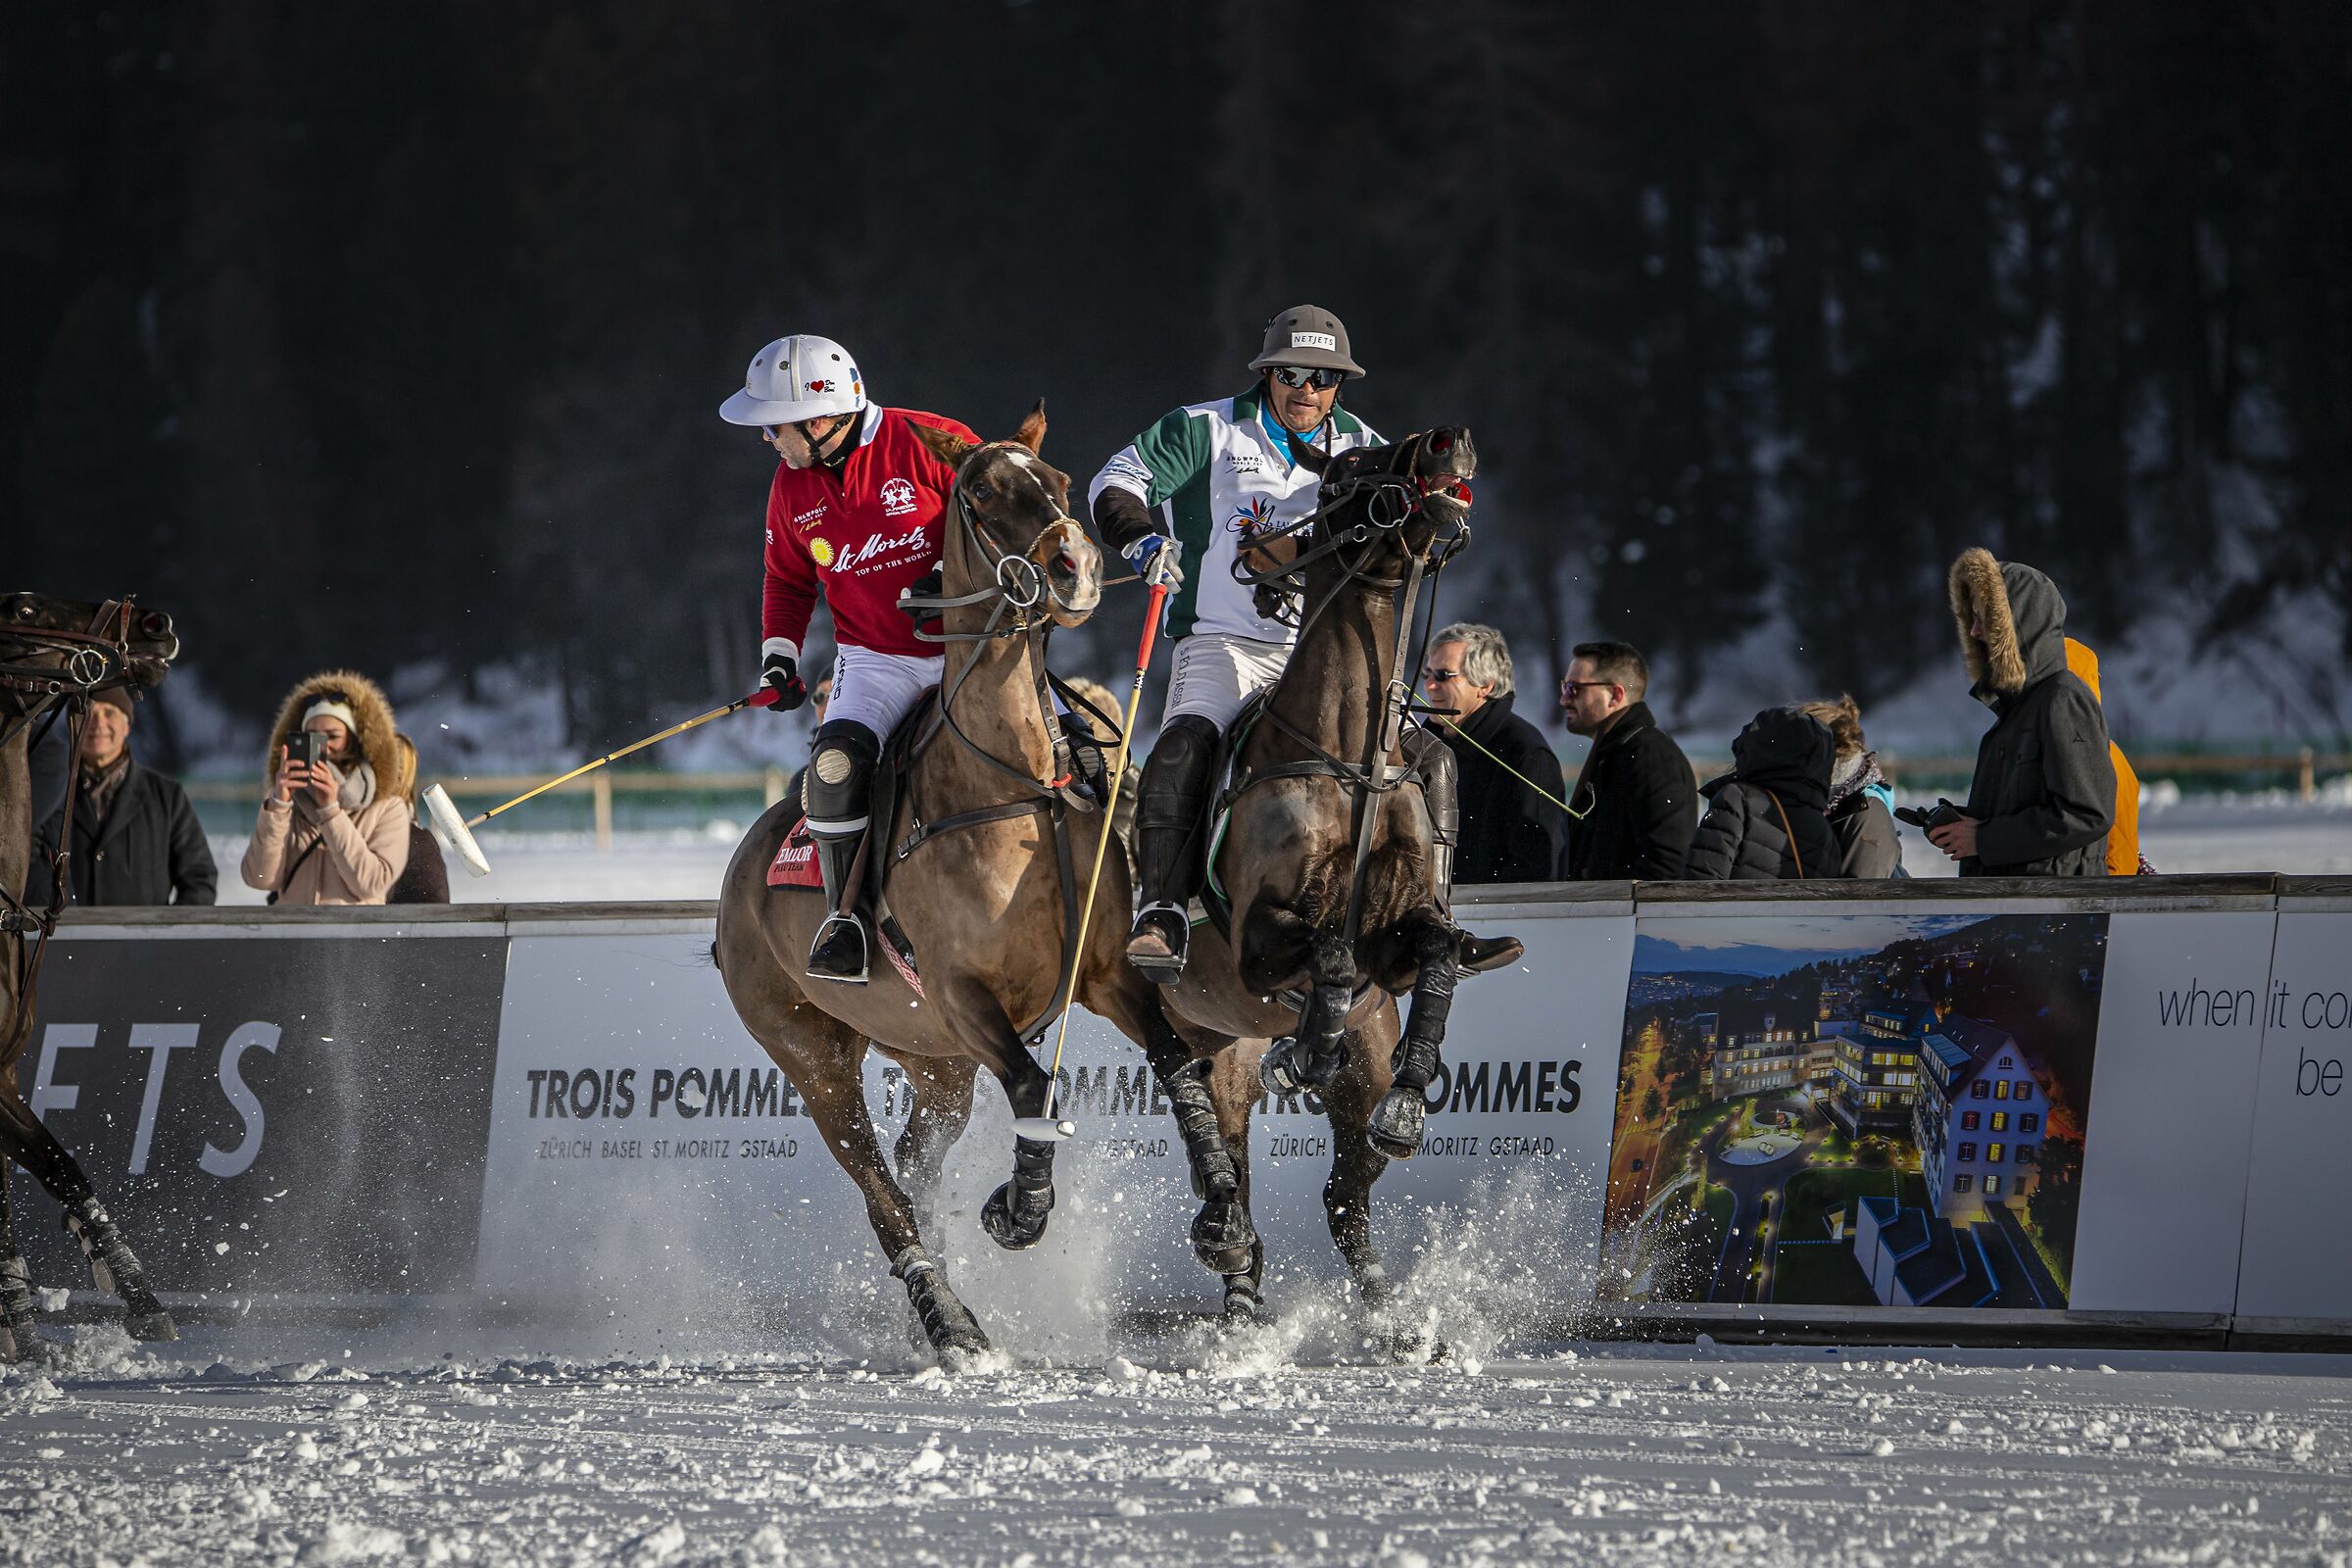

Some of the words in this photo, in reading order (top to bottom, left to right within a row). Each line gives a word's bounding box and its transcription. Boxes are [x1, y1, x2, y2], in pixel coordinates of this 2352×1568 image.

[1294, 335, 1334, 346] NETJETS
[852, 526, 925, 565] Moritz
[855, 567, 870, 577] TOP
[885, 560, 903, 568] THE
[904, 551, 932, 564] WORL
[2159, 977, 2255, 1026] when
[2270, 980, 2290, 1028] it
[2303, 992, 2352, 1029] co
[1424, 1059, 1583, 1114] OMMES
[2296, 1046, 2343, 1097] be
[527, 1068, 637, 1119] TROIS
[602, 1140, 643, 1158] BASEL
[674, 1139, 730, 1159] MORITZ
[740, 1137, 799, 1158] GSTAAD
[1270, 1134, 1326, 1157] ZÜRICH
[1417, 1137, 1478, 1156] MORITZ
[1490, 1137, 1554, 1156] GSTAAD
